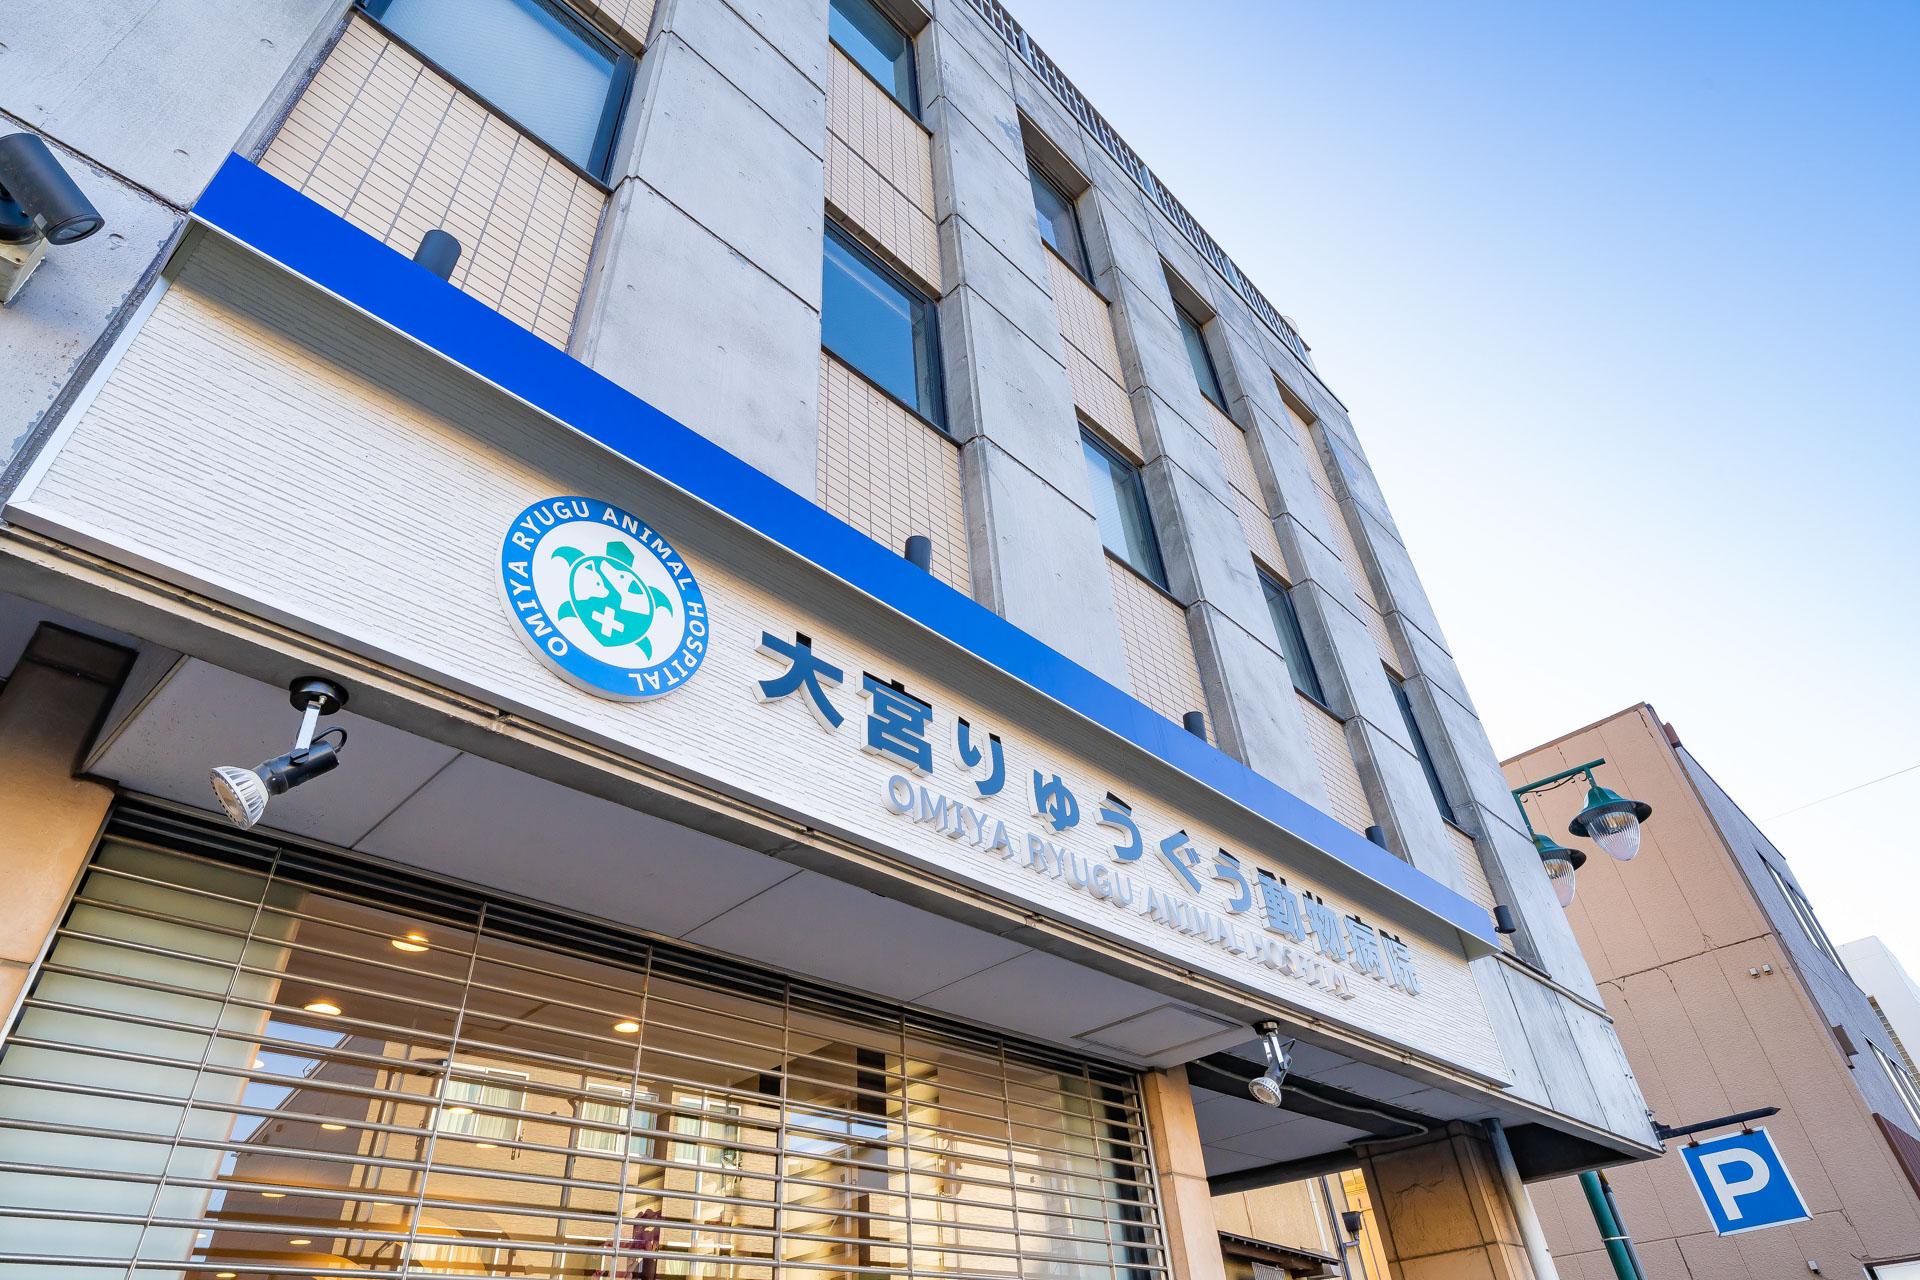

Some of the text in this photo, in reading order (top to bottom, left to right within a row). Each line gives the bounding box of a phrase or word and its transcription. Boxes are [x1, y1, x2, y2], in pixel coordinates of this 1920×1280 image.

[507, 499, 706, 693] OMIYA RYUGU ANIMAL HOSPITAL
[884, 773, 1014, 860] OMIYA
[1022, 831, 1134, 908] RYUGU
[1140, 886, 1245, 955] ANIMAL
[1698, 1147, 1771, 1221] P
